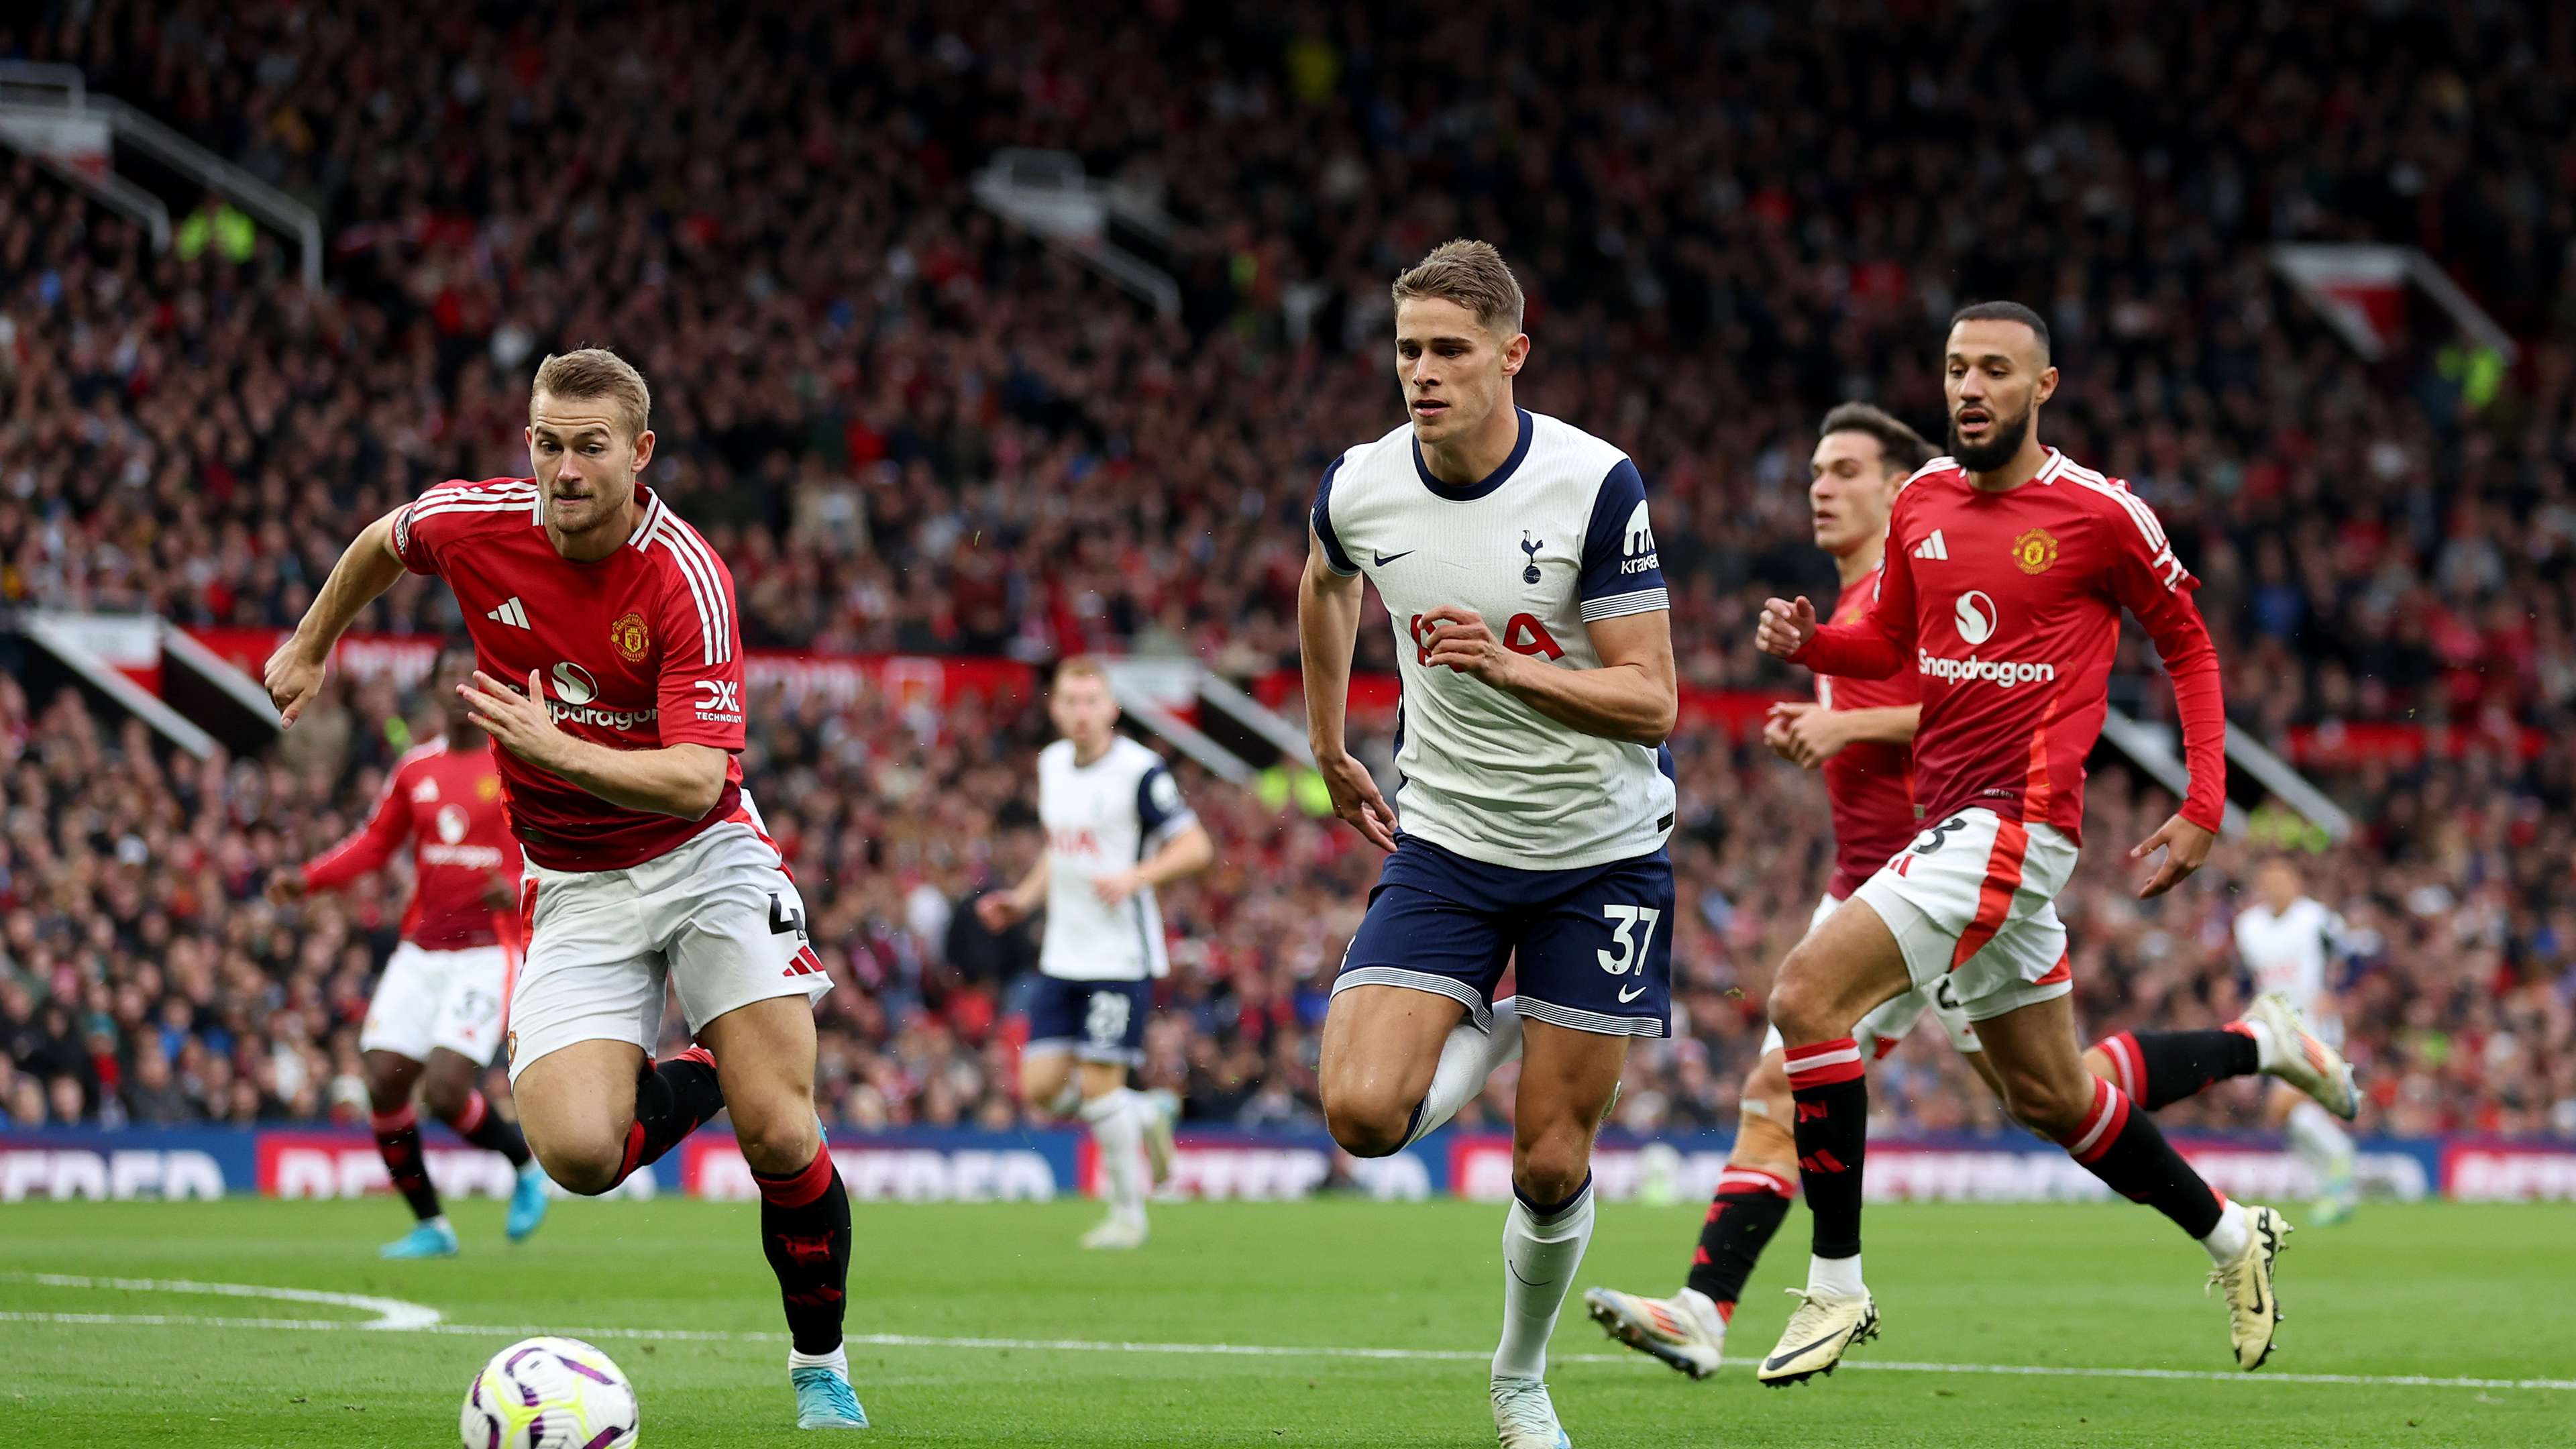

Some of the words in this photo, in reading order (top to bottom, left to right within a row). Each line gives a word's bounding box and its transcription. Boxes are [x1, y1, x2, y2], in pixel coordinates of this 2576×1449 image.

[1410, 612, 1566, 673] AA
[1918, 647, 2055, 688] Snapdragon
[769, 893, 808, 941] 4
[1597, 904, 1661, 977] 37
